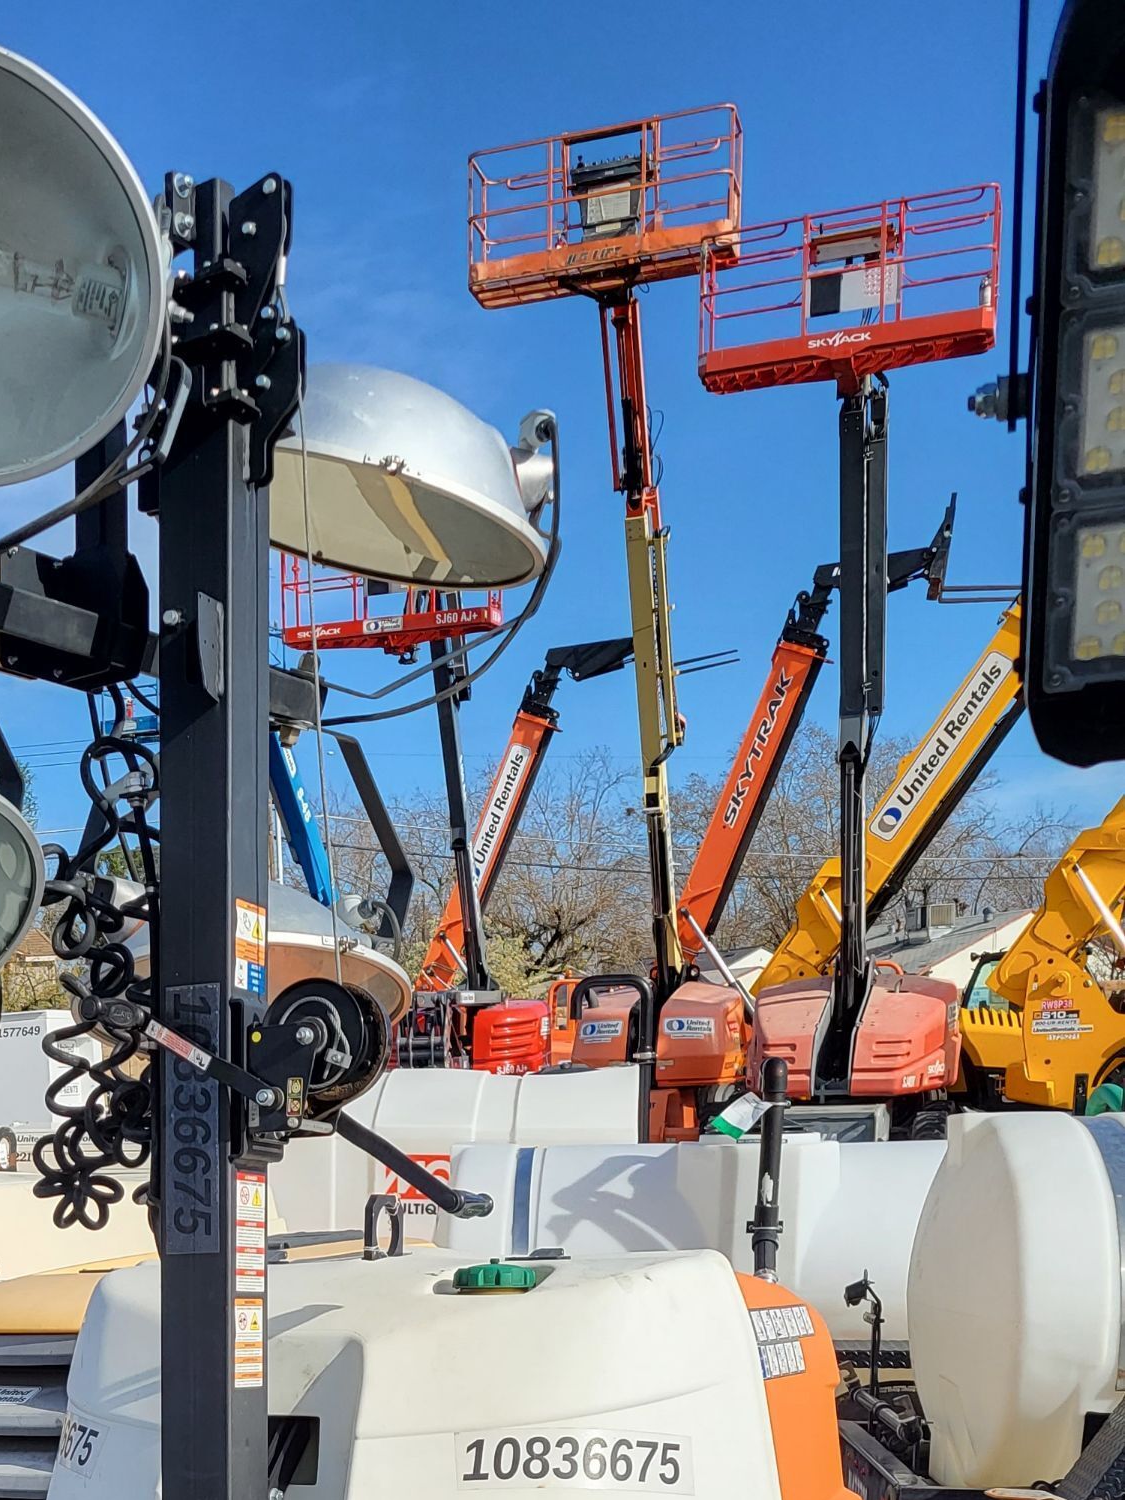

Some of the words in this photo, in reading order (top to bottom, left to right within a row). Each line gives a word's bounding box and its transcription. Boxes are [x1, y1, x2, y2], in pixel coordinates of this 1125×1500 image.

[808, 331, 872, 349] SKYJACK
[436, 612, 458, 624] SJ60
[460, 610, 478, 622] AJ+
[724, 667, 794, 829] SKYTRAK
[897, 738, 949, 807] United
[943, 664, 1002, 740] Rentals
[475, 811, 501, 865] United
[494, 752, 524, 812] Rentals
[463, 1436, 681, 1485] 10836675
